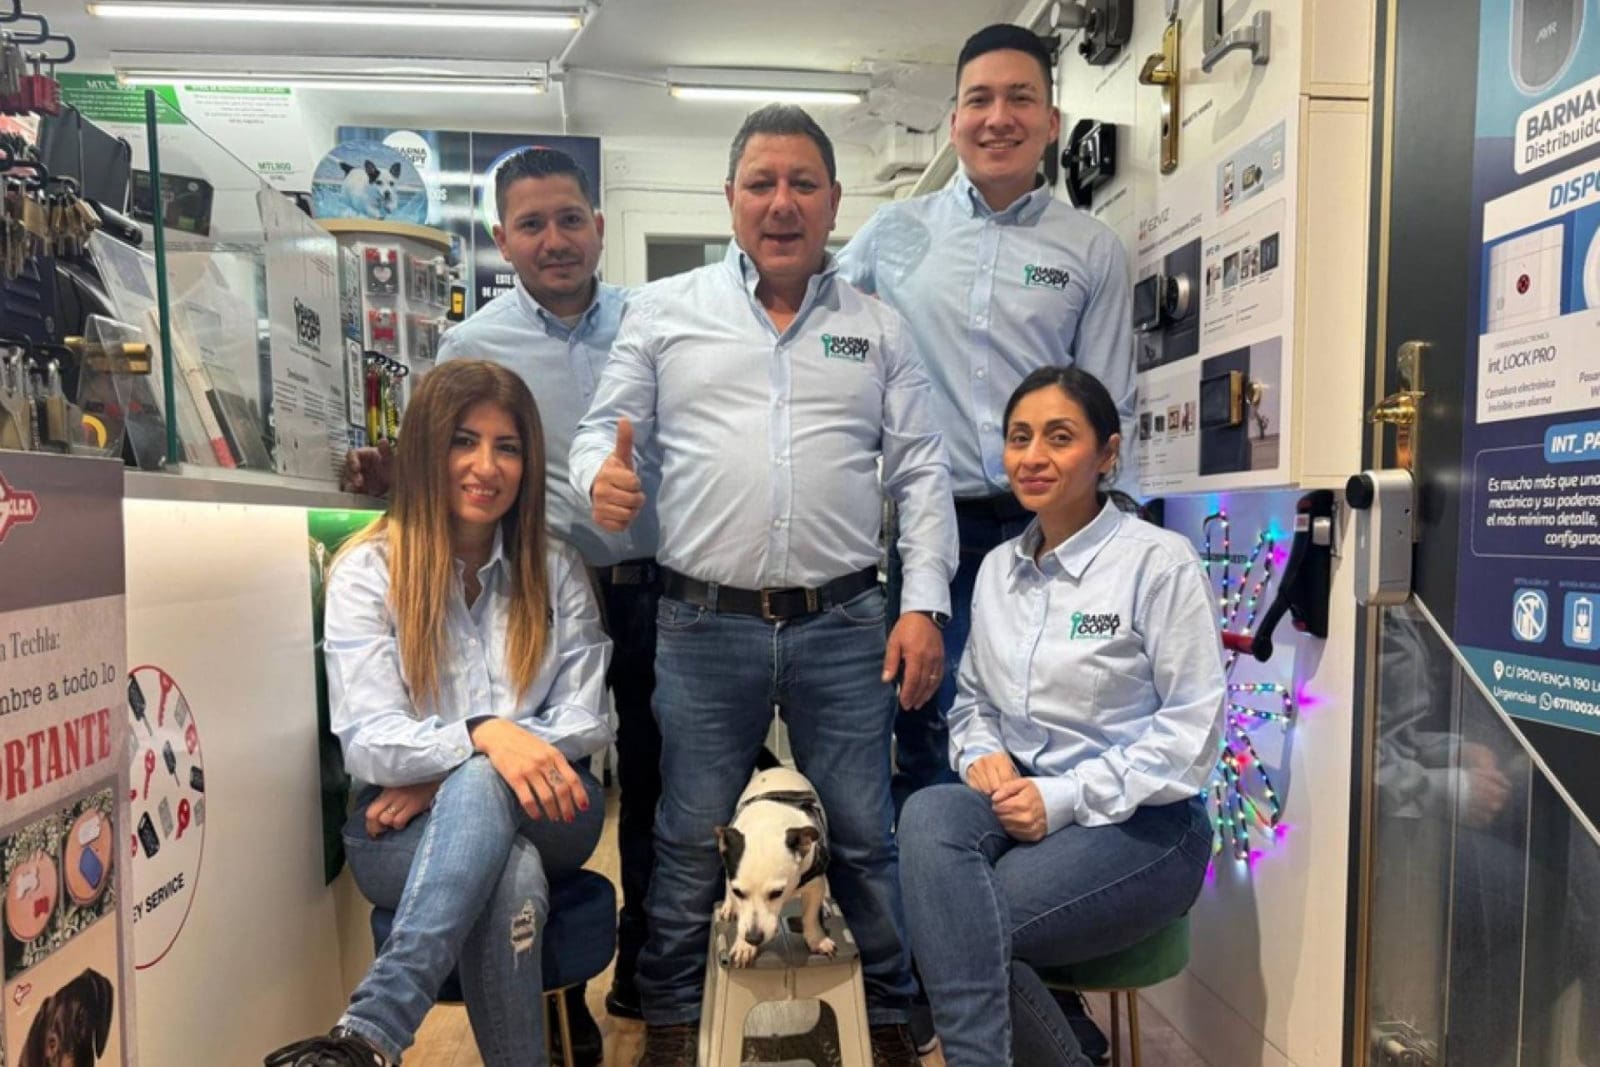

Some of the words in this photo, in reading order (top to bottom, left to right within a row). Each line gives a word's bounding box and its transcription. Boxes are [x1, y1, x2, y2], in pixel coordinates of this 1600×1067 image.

[1526, 88, 1600, 141] BARNA
[1532, 345, 1556, 365] PRO
[1488, 478, 1499, 491] Es
[1500, 475, 1533, 490] mucho
[1558, 476, 1578, 491] que
[1543, 497, 1555, 508] su
[1486, 513, 1496, 526] el
[1078, 621, 1117, 636] COPY
[47, 681, 59, 698] a
[62, 667, 98, 697] todo
[101, 662, 116, 686] lo
[1573, 676, 1590, 691] 190
[1493, 685, 1537, 705] Urgencias
[0, 707, 112, 801] RTANTE
[145, 872, 185, 912] SERVICE
